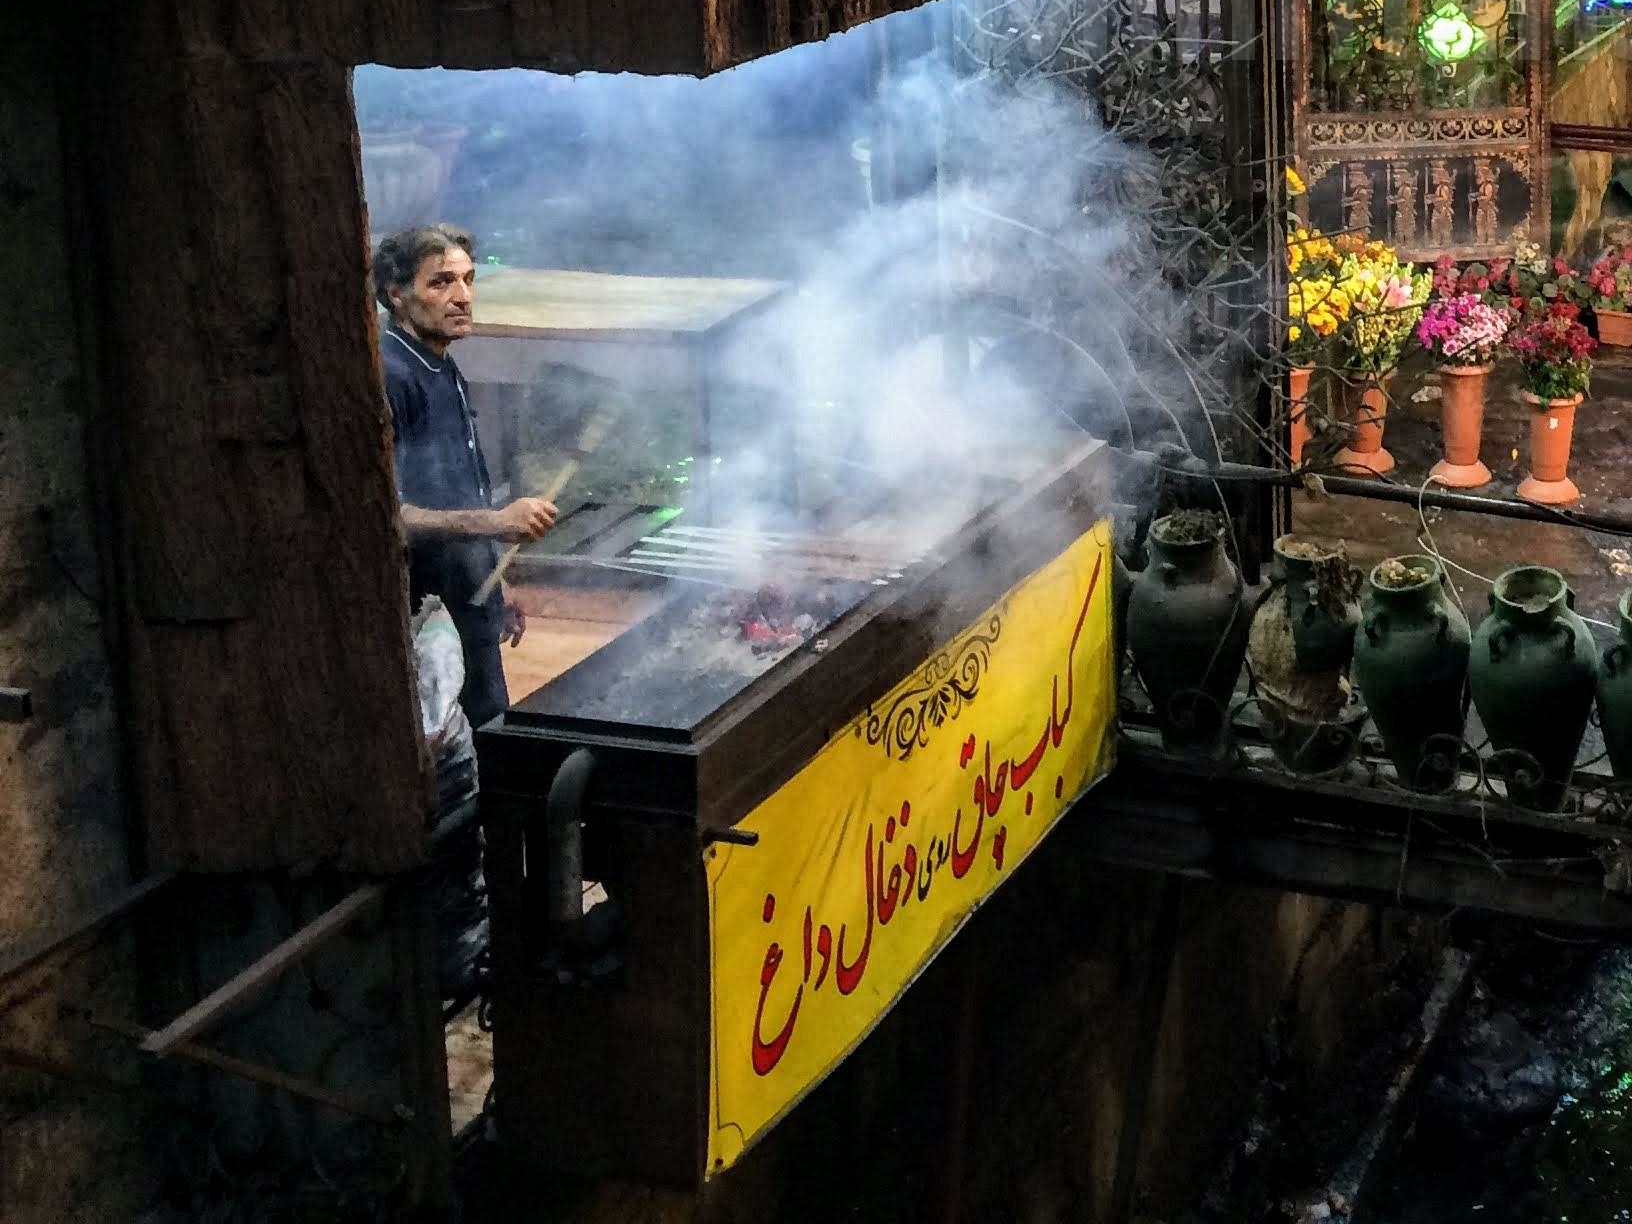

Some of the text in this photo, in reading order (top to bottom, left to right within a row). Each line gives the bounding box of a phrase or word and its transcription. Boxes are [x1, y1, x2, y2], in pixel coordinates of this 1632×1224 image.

[1010, 551, 1102, 816] کباب
[917, 832, 951, 903] روی
[951, 733, 1009, 879] چاق
[752, 892, 832, 1076] داغ
